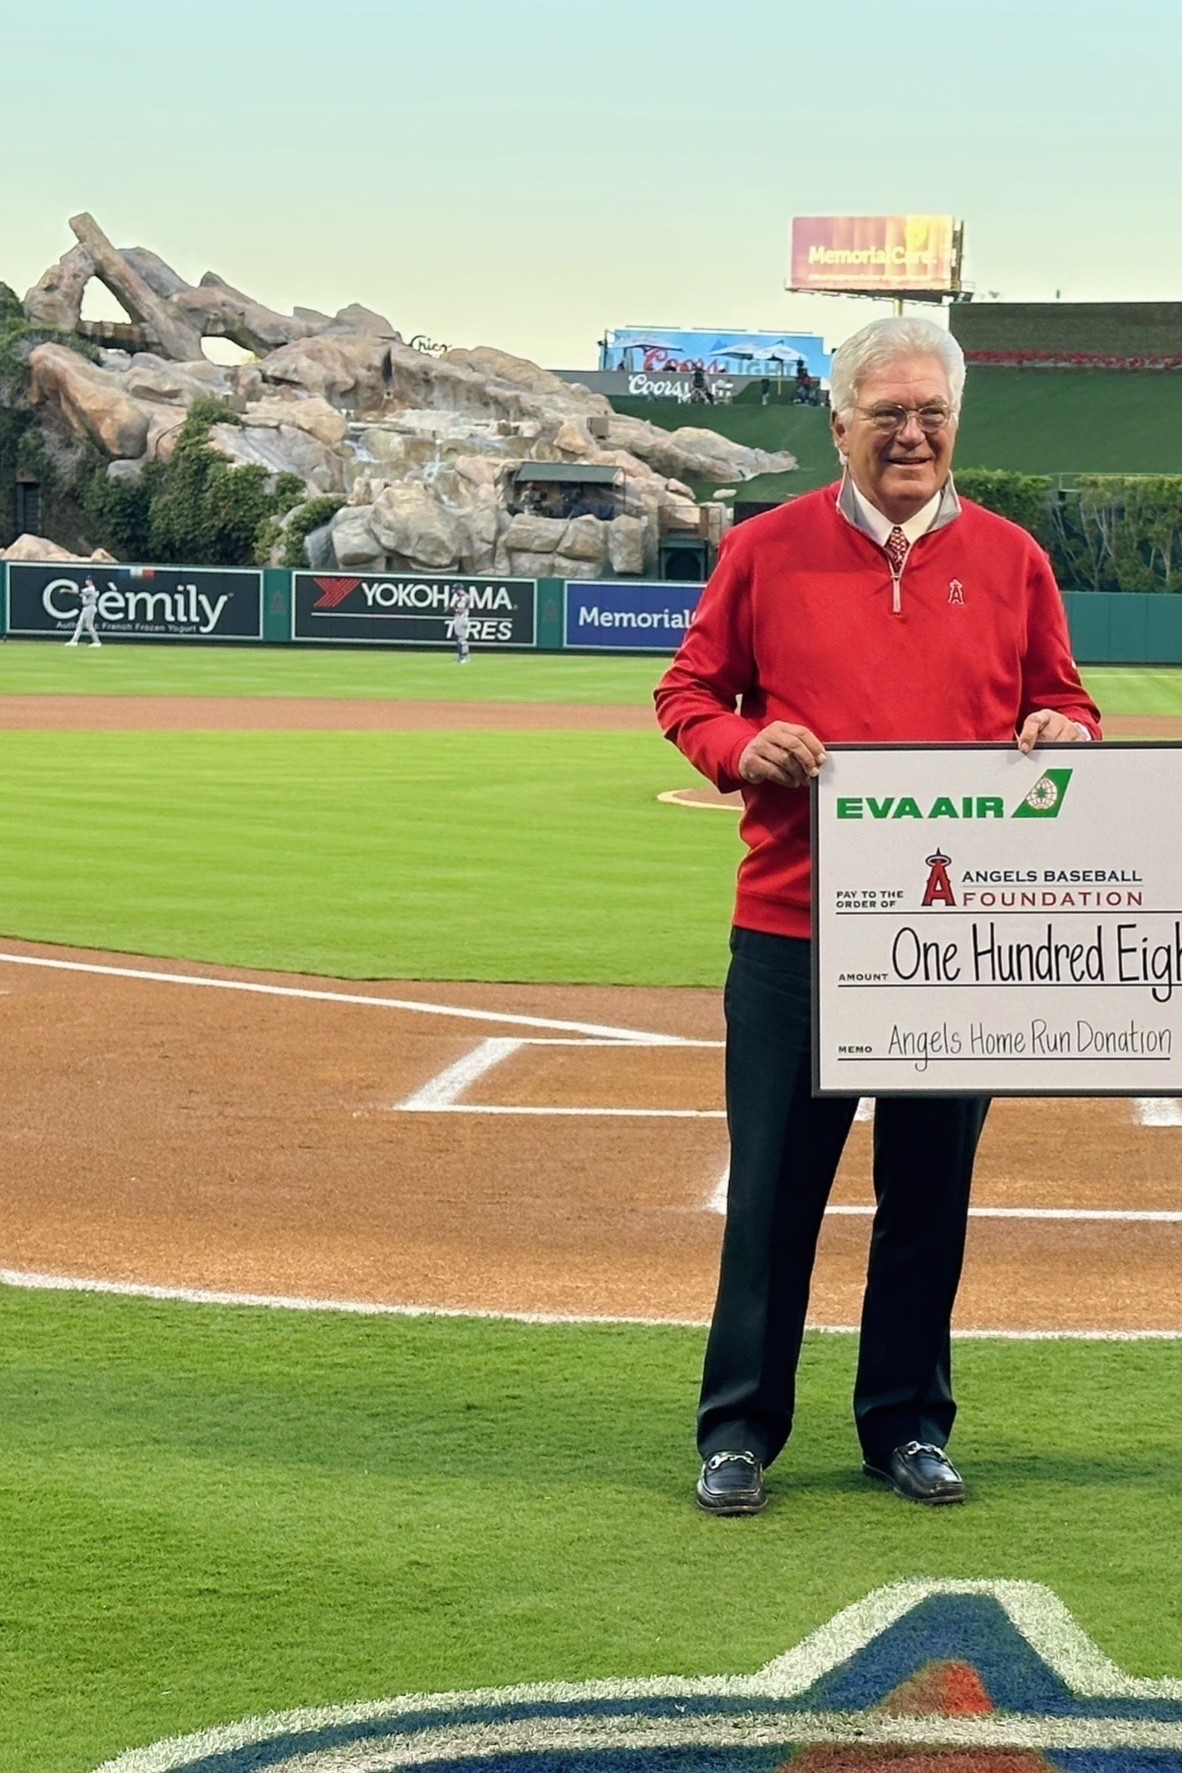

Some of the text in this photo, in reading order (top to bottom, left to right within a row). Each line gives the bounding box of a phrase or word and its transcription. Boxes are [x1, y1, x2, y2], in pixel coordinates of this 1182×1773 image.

[628, 374, 683, 396] Coors
[42, 579, 229, 633] Cèmily
[578, 606, 697, 629] Memorial
[102, 622, 134, 631] French
[135, 623, 166, 632] Frozen
[444, 620, 513, 641] TRES
[961, 869, 1143, 882] ANGELS BASEBALL
[836, 891, 858, 899] PAY
[861, 891, 877, 899] TO
[963, 891, 1142, 906] FOUNDATION
[892, 927, 960, 981] One
[972, 922, 1104, 982] Hundred
[838, 973, 889, 981] AMOUNT
[838, 1045, 873, 1053] MEMO
[888, 1018, 1172, 1072] Angels Home Run Donation
